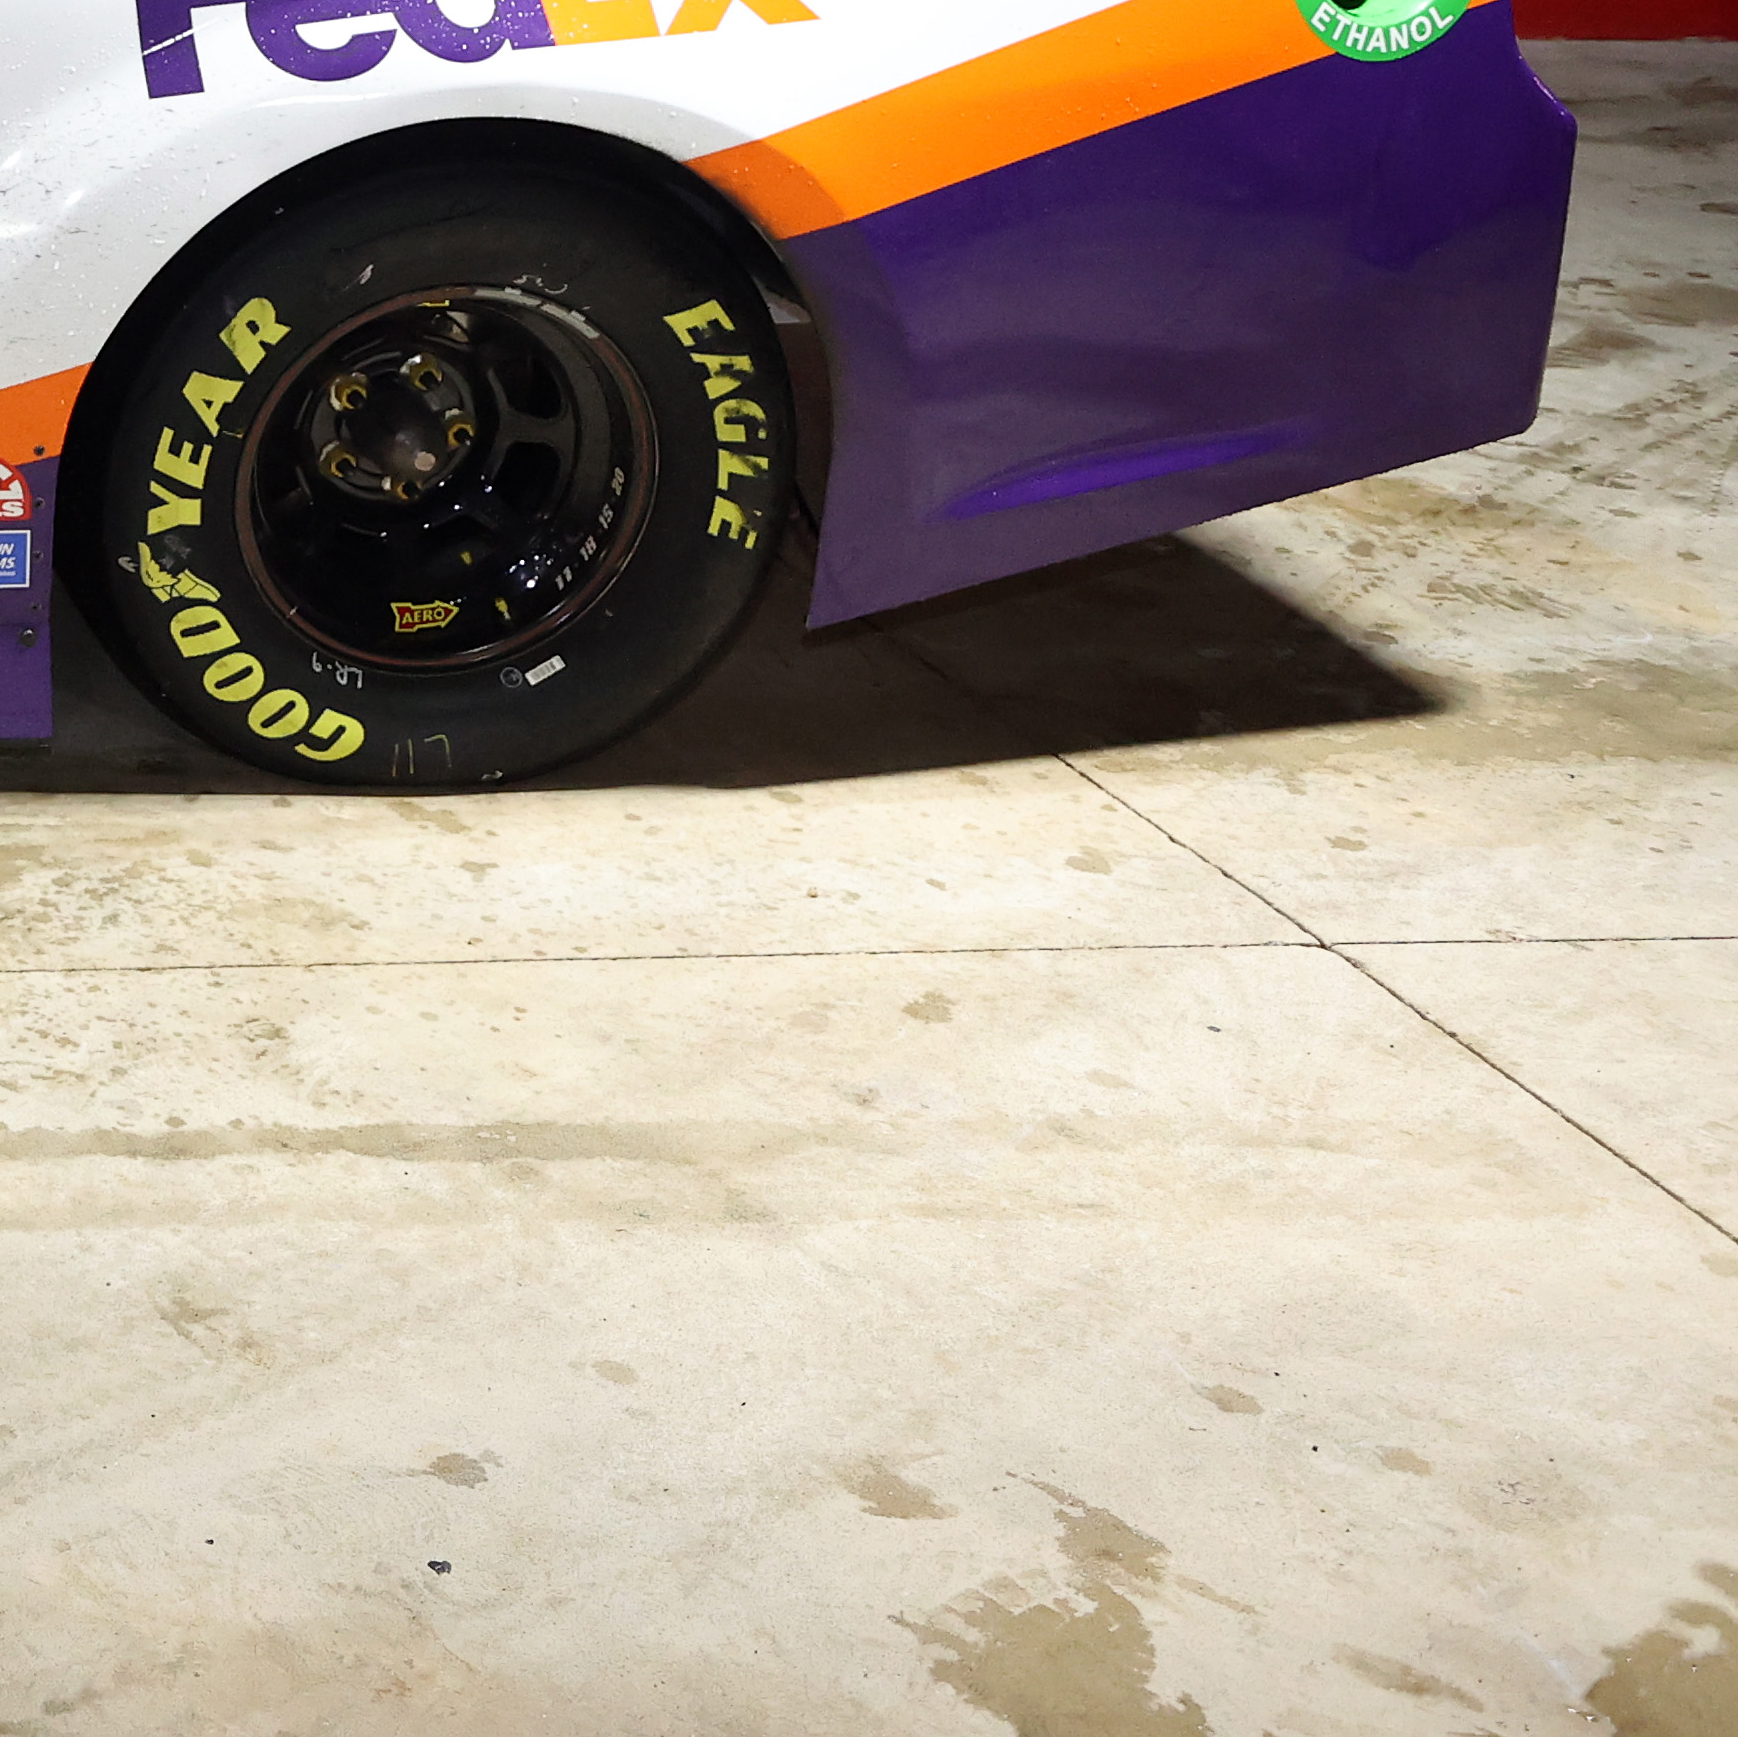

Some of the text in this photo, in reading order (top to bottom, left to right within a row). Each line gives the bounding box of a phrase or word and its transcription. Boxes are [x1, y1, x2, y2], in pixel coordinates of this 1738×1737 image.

[1310, 2, 1454, 53] ETHANOL
[662, 298, 768, 550] EAGLE
[400, 607, 447, 625] AERO
